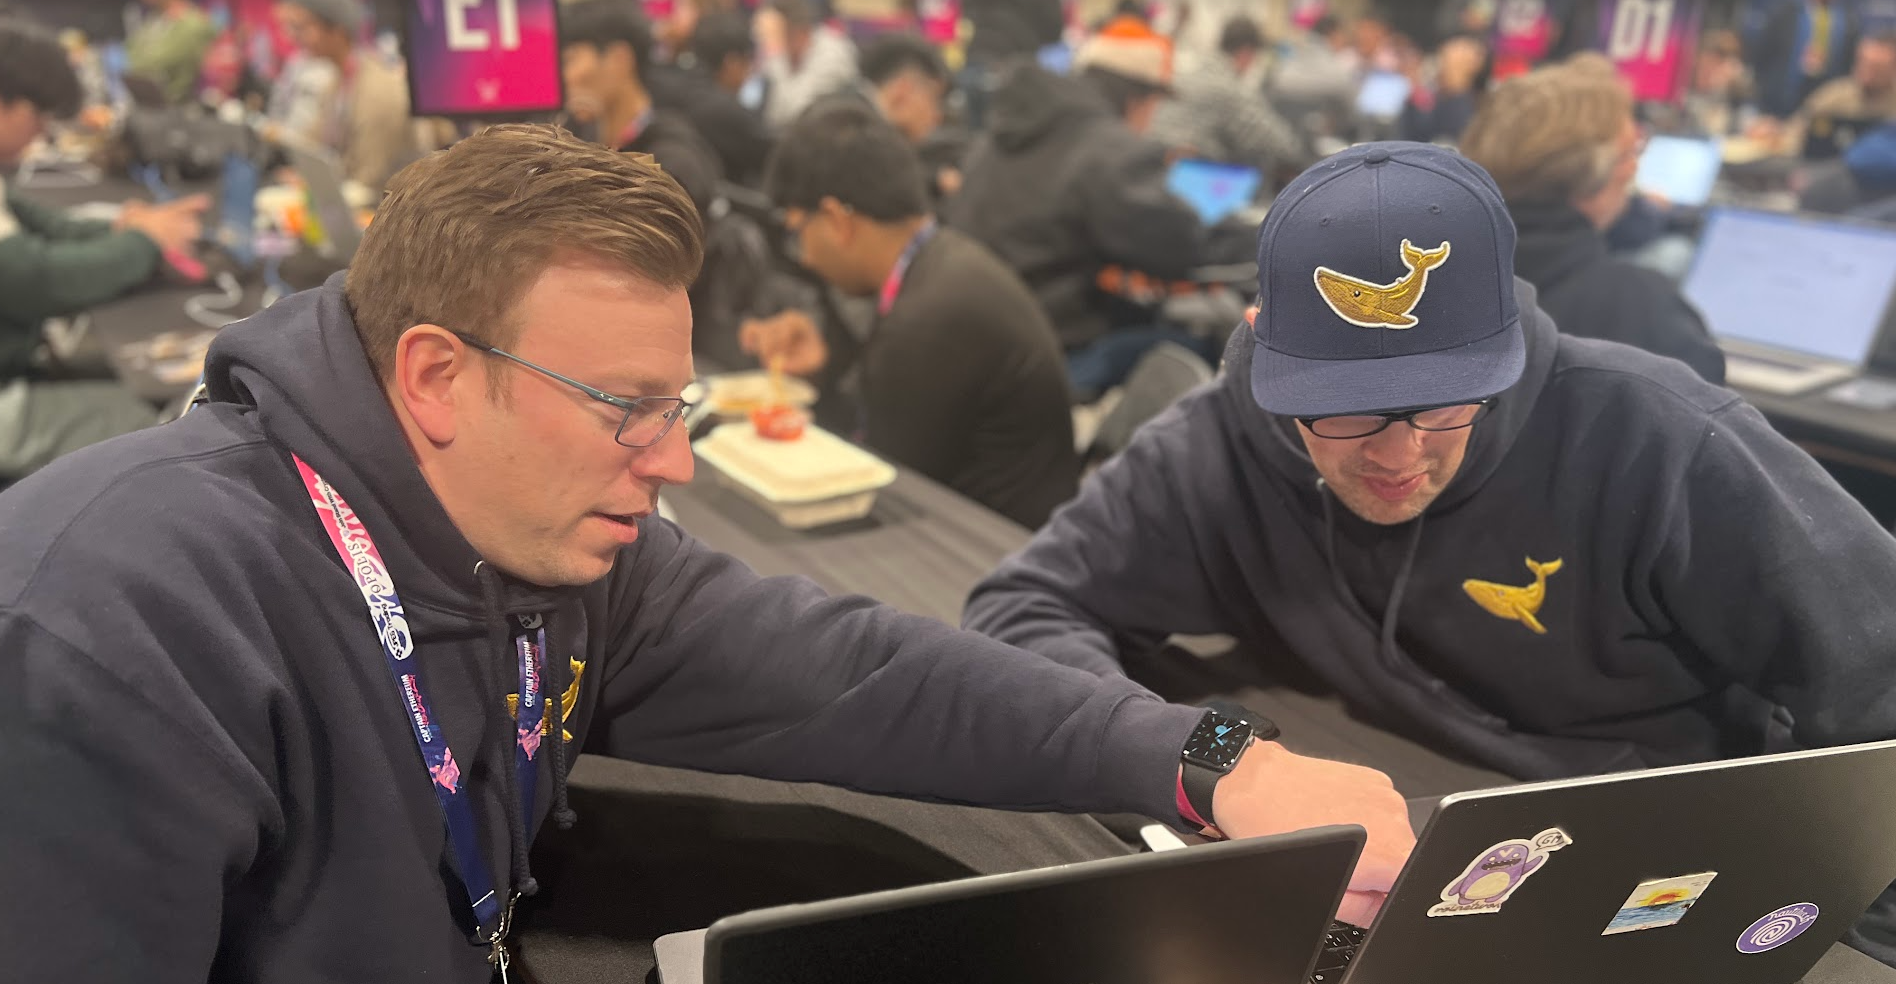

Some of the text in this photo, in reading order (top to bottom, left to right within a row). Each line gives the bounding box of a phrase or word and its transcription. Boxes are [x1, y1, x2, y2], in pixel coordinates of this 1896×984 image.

[347, 542, 382, 594] OPOLIS
[401, 673, 419, 713] ETHEREUM
[525, 679, 534, 708] CAPTAIN
[414, 711, 432, 743] CAPTAIN
